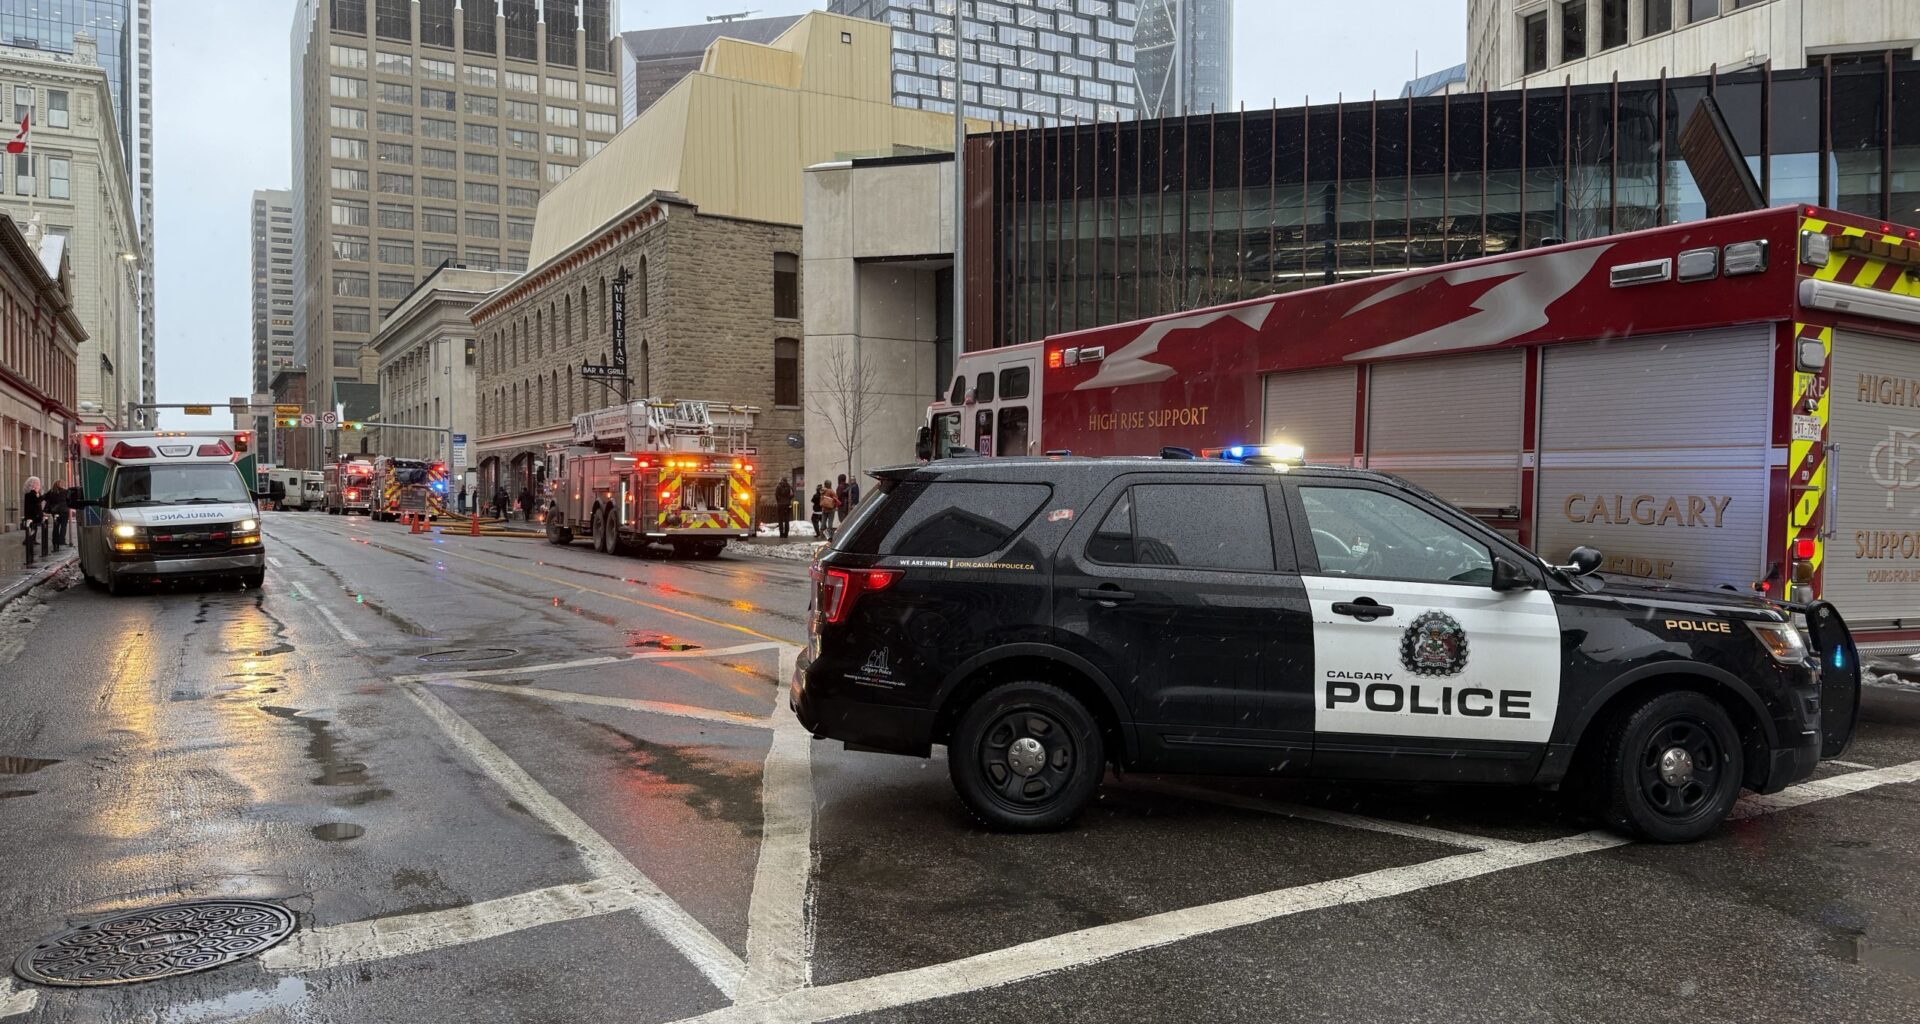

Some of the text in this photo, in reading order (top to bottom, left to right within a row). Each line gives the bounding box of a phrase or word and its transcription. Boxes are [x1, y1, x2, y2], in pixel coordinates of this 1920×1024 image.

[614, 285, 625, 365] MURRIETA'S
[1798, 374, 1826, 397] FIRE
[1857, 373, 1905, 406] HIGH
[1088, 407, 1209, 431] HIGH RISE SUPPORT
[1564, 493, 1732, 527] CALGARY
[955, 561, 1035, 570] JOIN.CALGARYPOLICE.CA
[1867, 569, 1893, 582] YOURS
[1664, 620, 1731, 633] POLICE
[861, 665, 878, 674] Calgary
[879, 667, 892, 675] Police
[1326, 670, 1393, 681] CALGARY
[1326, 681, 1532, 719] POLICE
